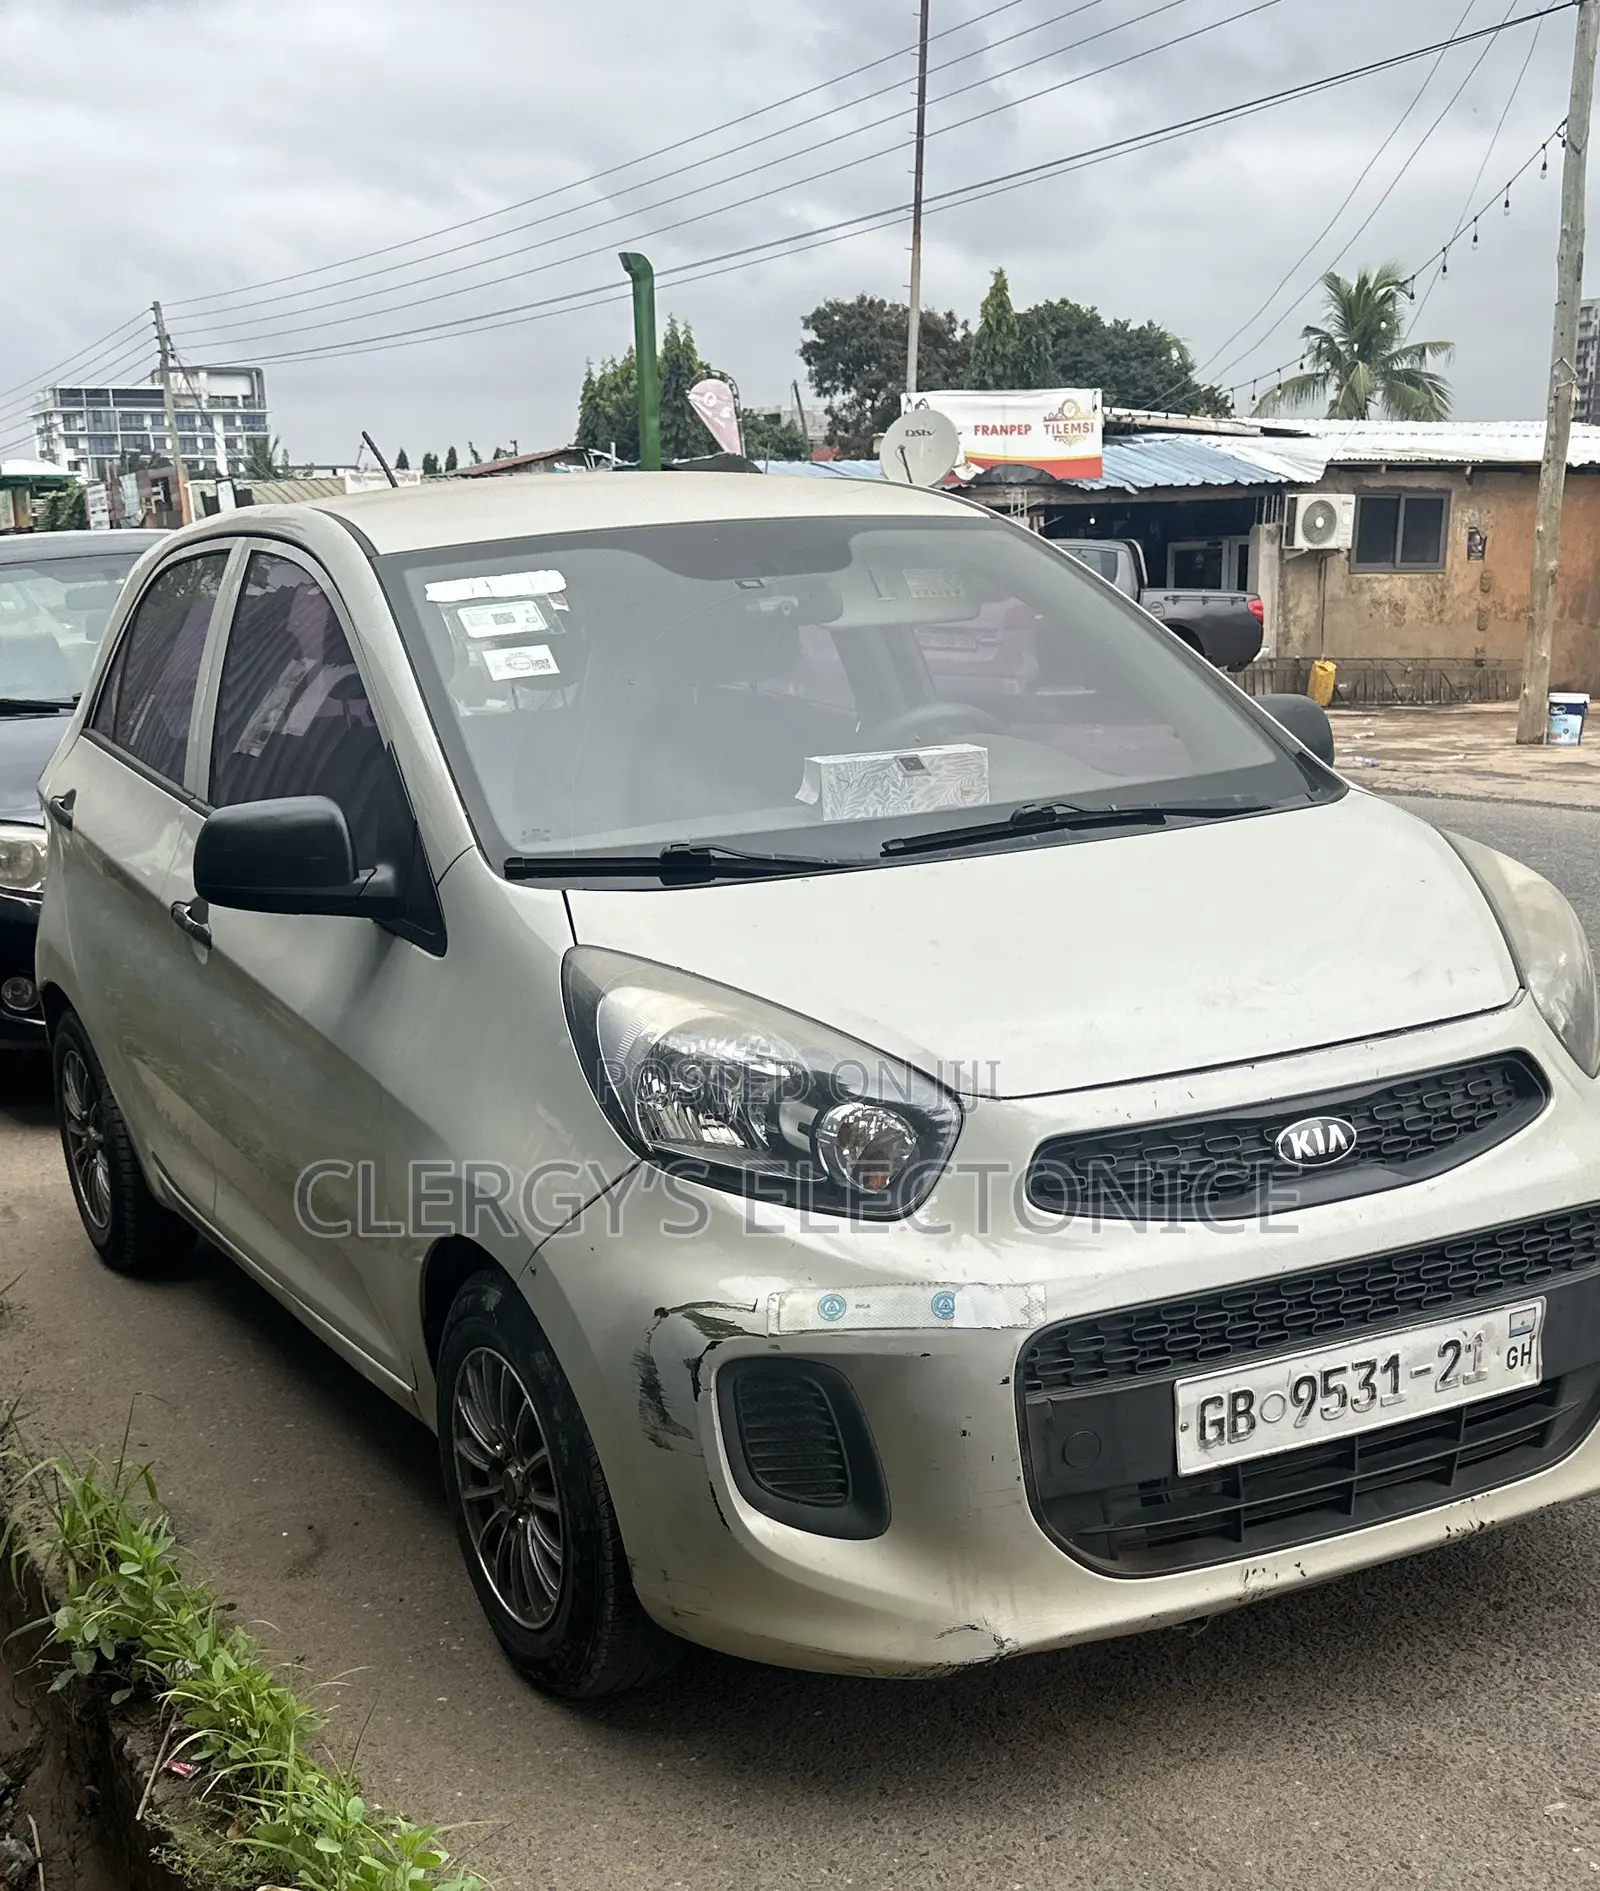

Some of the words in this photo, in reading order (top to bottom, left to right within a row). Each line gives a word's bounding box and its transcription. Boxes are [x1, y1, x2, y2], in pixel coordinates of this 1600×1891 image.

[974, 424, 1032, 436] FRANPEP
[1043, 422, 1095, 434] TILEMSI
[1288, 1124, 1348, 1160] KIA
[1506, 1340, 1533, 1370] GH
[1196, 1385, 1258, 1449] GB
